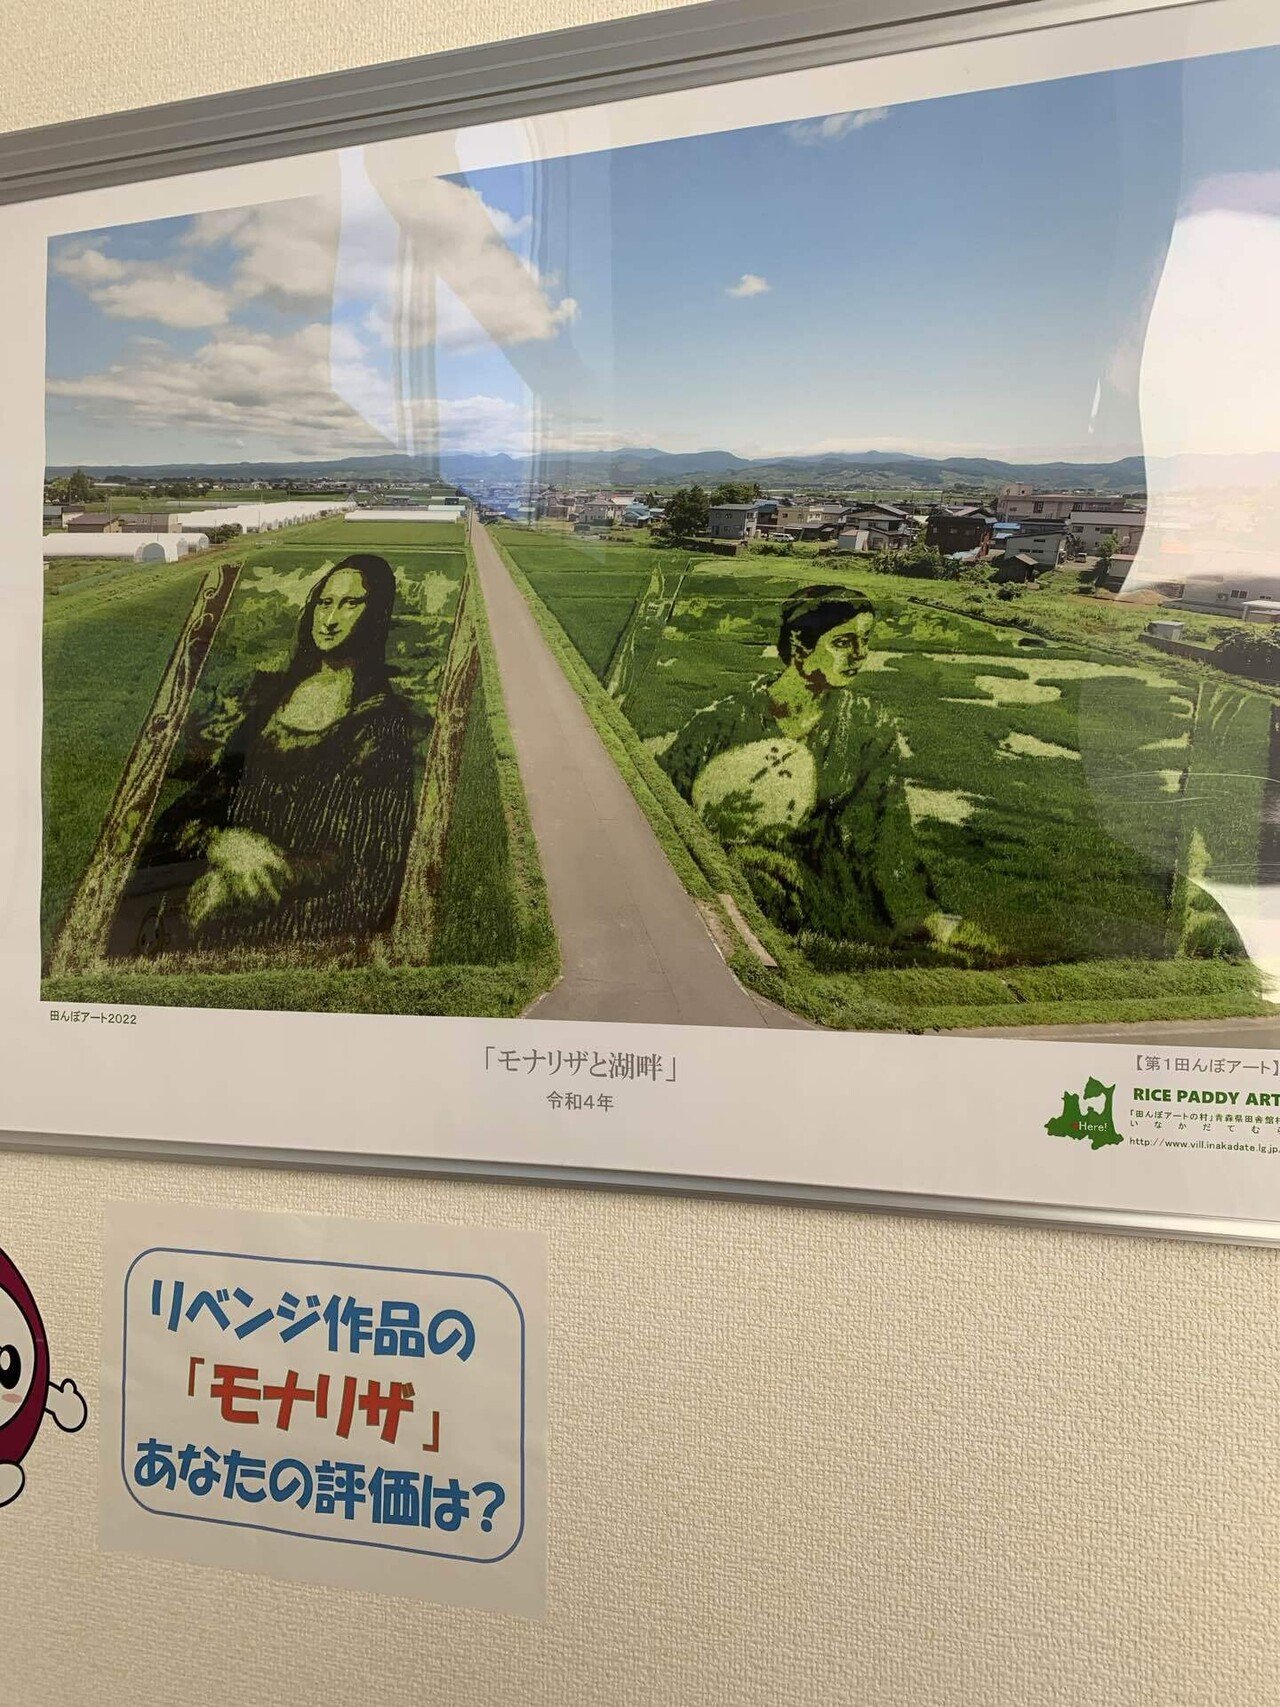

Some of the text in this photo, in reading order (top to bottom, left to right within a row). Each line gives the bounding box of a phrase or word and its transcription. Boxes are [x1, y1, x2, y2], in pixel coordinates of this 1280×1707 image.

[50, 1010, 137, 1025] 田んぼアート2022
[485, 1046, 676, 1083] 「モナリザと湖畔」
[546, 1090, 615, 1112] 令和4年
[1133, 1087, 1280, 1107] RICE PADDY ART
[1079, 1121, 1108, 1132] Here!
[151, 1279, 476, 1362] リベンジ作品の
[187, 1356, 440, 1453] 「モナリザ」
